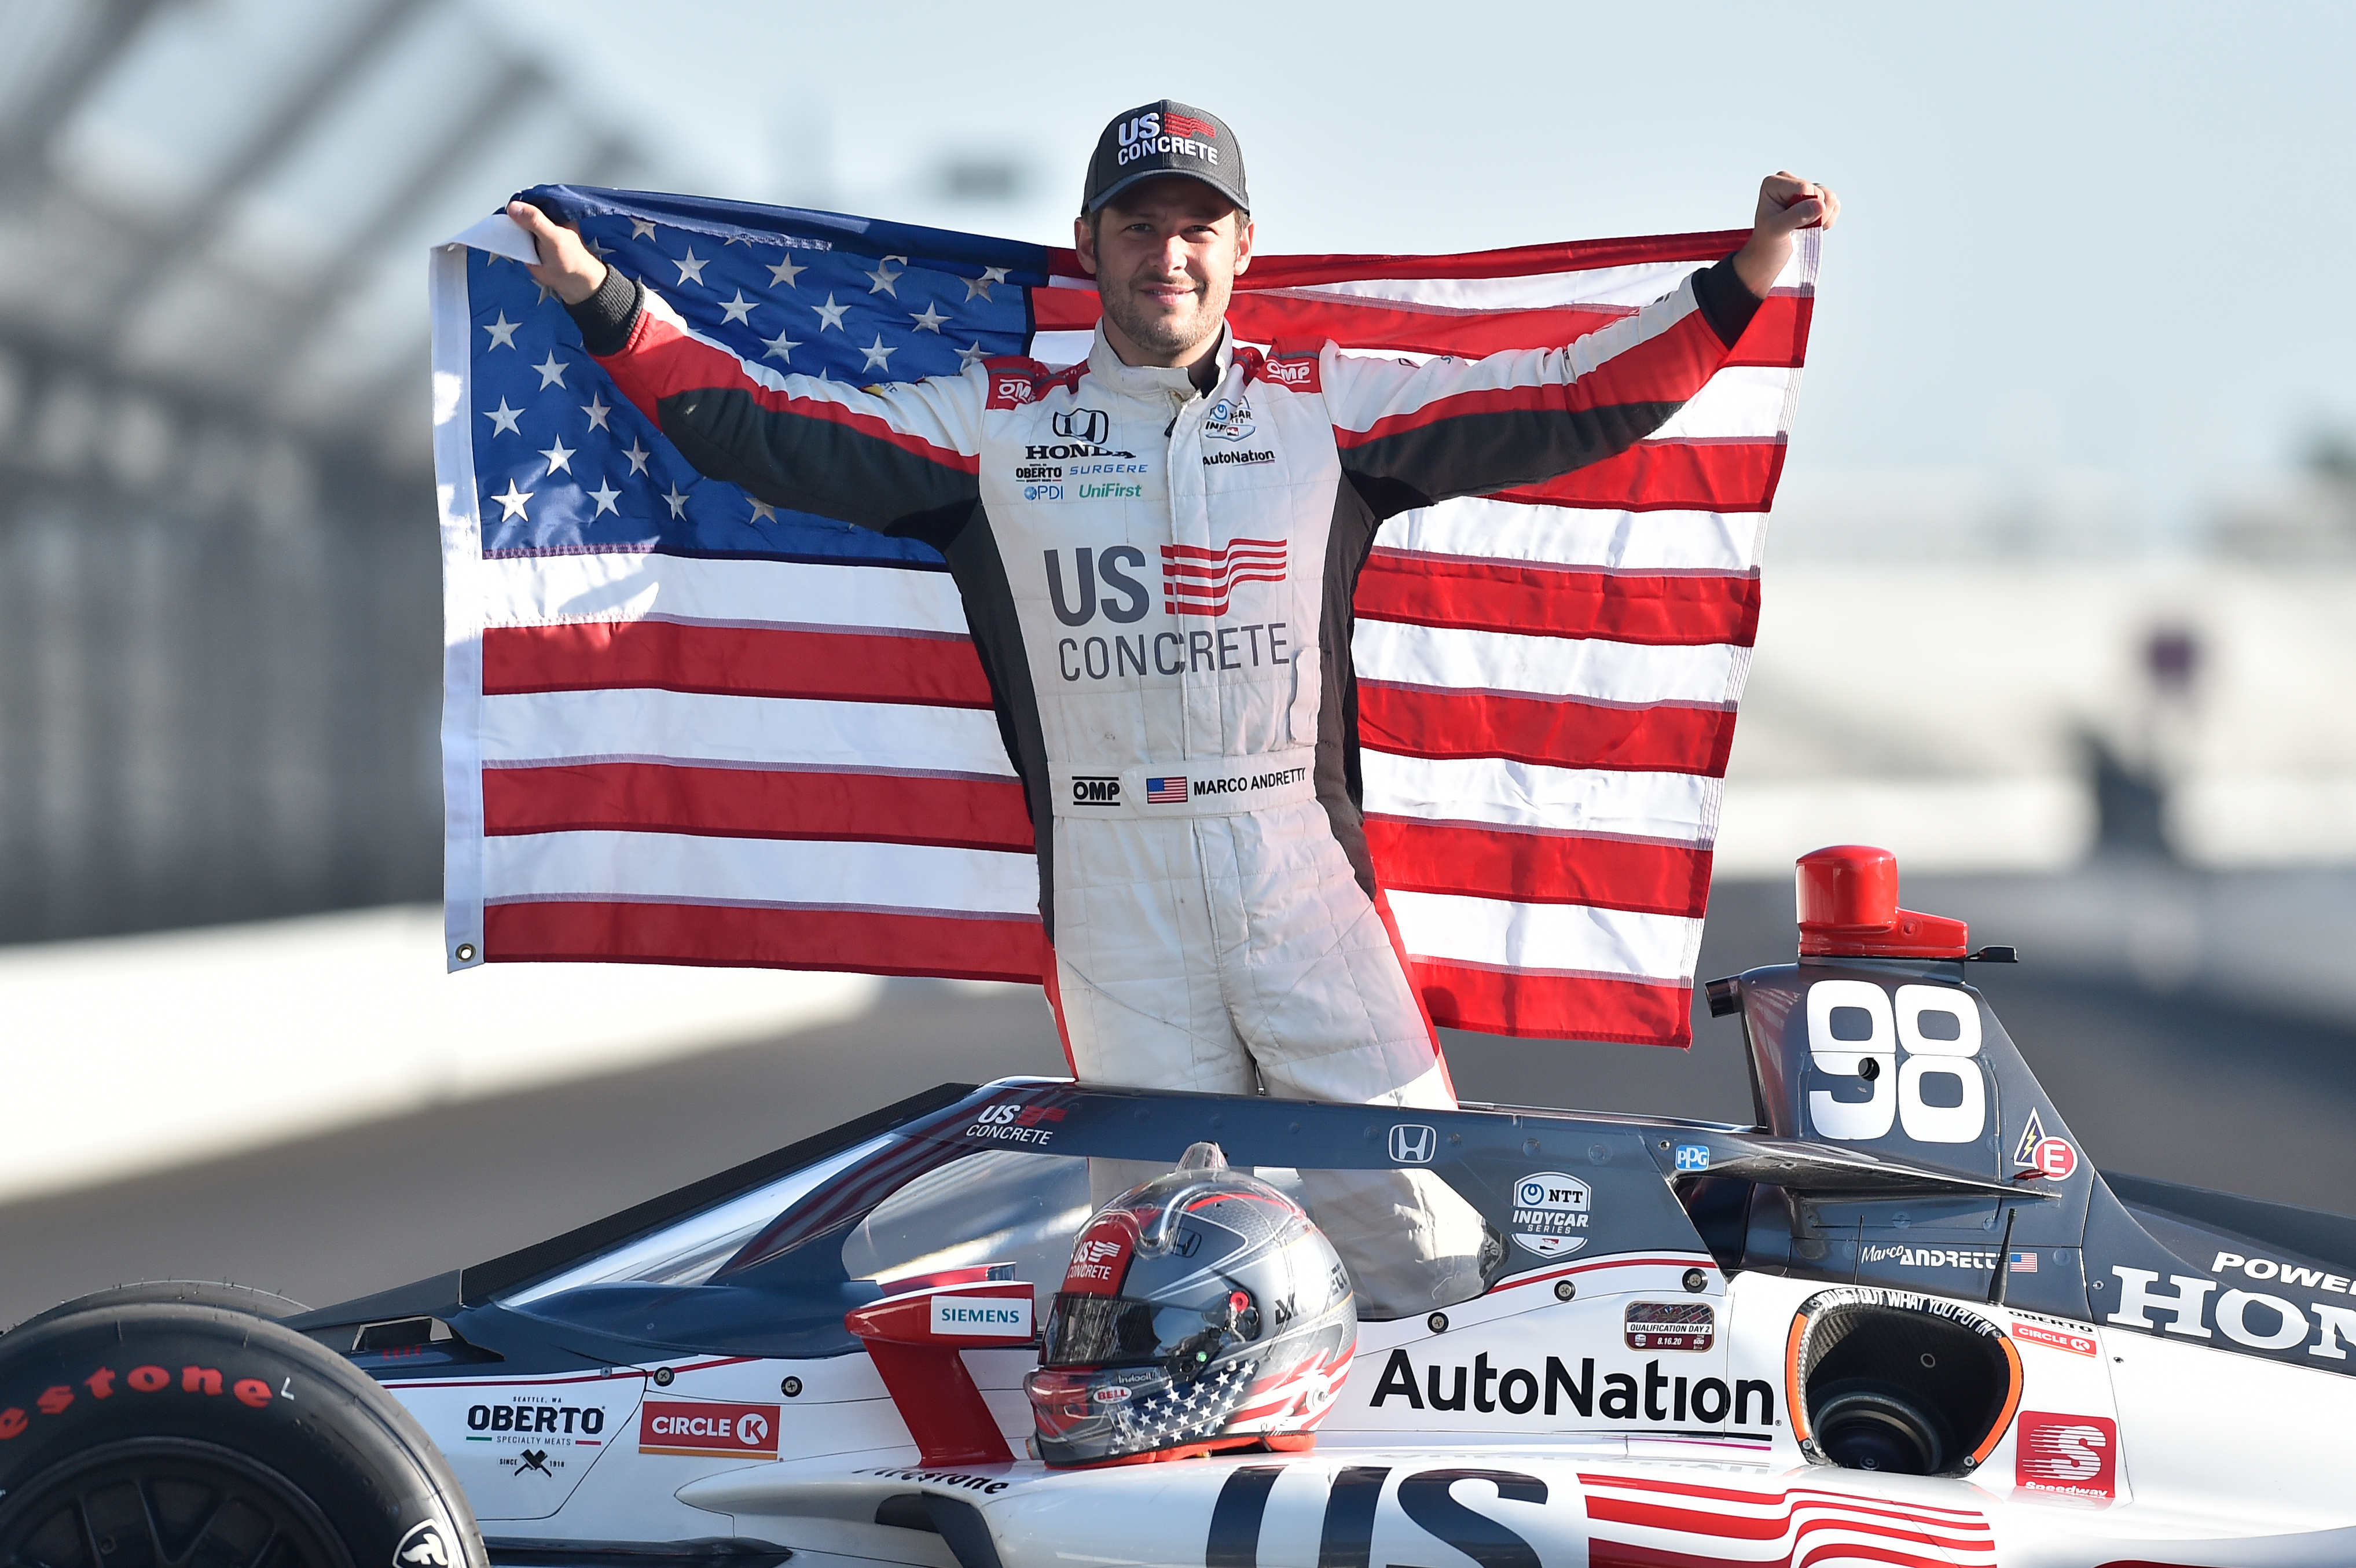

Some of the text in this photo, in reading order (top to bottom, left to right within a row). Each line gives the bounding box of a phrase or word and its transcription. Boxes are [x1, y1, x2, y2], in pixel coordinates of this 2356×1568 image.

[1118, 112, 1160, 146] US
[1118, 137, 1218, 166] CONCRETE
[1266, 362, 1310, 381] OMP
[1203, 450, 1275, 465] AutoNation
[1016, 467, 1062, 478] OBERTO
[1070, 464, 1148, 475] SURGERE
[1038, 486, 1063, 500] PDI
[1079, 483, 1142, 498] UniFirst
[1044, 545, 1150, 627] US
[1059, 623, 1290, 682] CONCRETE
[1073, 781, 1121, 801] OMP
[1194, 777, 1247, 796] MARCO
[1807, 980, 1986, 1143] 98
[978, 1104, 1021, 1124] US
[966, 1125, 1054, 1145] CONCRETE
[1678, 1147, 1707, 1169] PPG
[2043, 1143, 2066, 1174] E
[1548, 1189, 1583, 1203] NTT
[1513, 1210, 1588, 1228] INDYCAR
[1527, 1224, 1572, 1234] SERIES
[1073, 1240, 1093, 1264] US
[1861, 1244, 2001, 1269] Marco ANDRETT
[1067, 1265, 1112, 1280] CONCRETE
[2211, 1251, 2356, 1295] POWE
[942, 1309, 1019, 1323] SIEMENS
[1858, 1288, 1883, 1305] OUT
[1886, 1291, 1928, 1311] WHAT
[1927, 1298, 1955, 1319] YOU
[1952, 1307, 1984, 1329] PUT
[1975, 1321, 1997, 1337] IN
[1630, 1324, 1687, 1332] QUALIFICATION
[2018, 1327, 2067, 1345] CIRCLE
[1657, 1337, 1682, 1345] 8.16.20
[1098, 1389, 1128, 1400] BELL
[1369, 1349, 1774, 1426] AutoNation
[468, 1405, 604, 1434] OBERTO
[652, 1416, 766, 1444] CIRCLE K
[497, 1436, 571, 1446] SPECIALTY MEATS
[2025, 1481, 2108, 1497] Speedway
